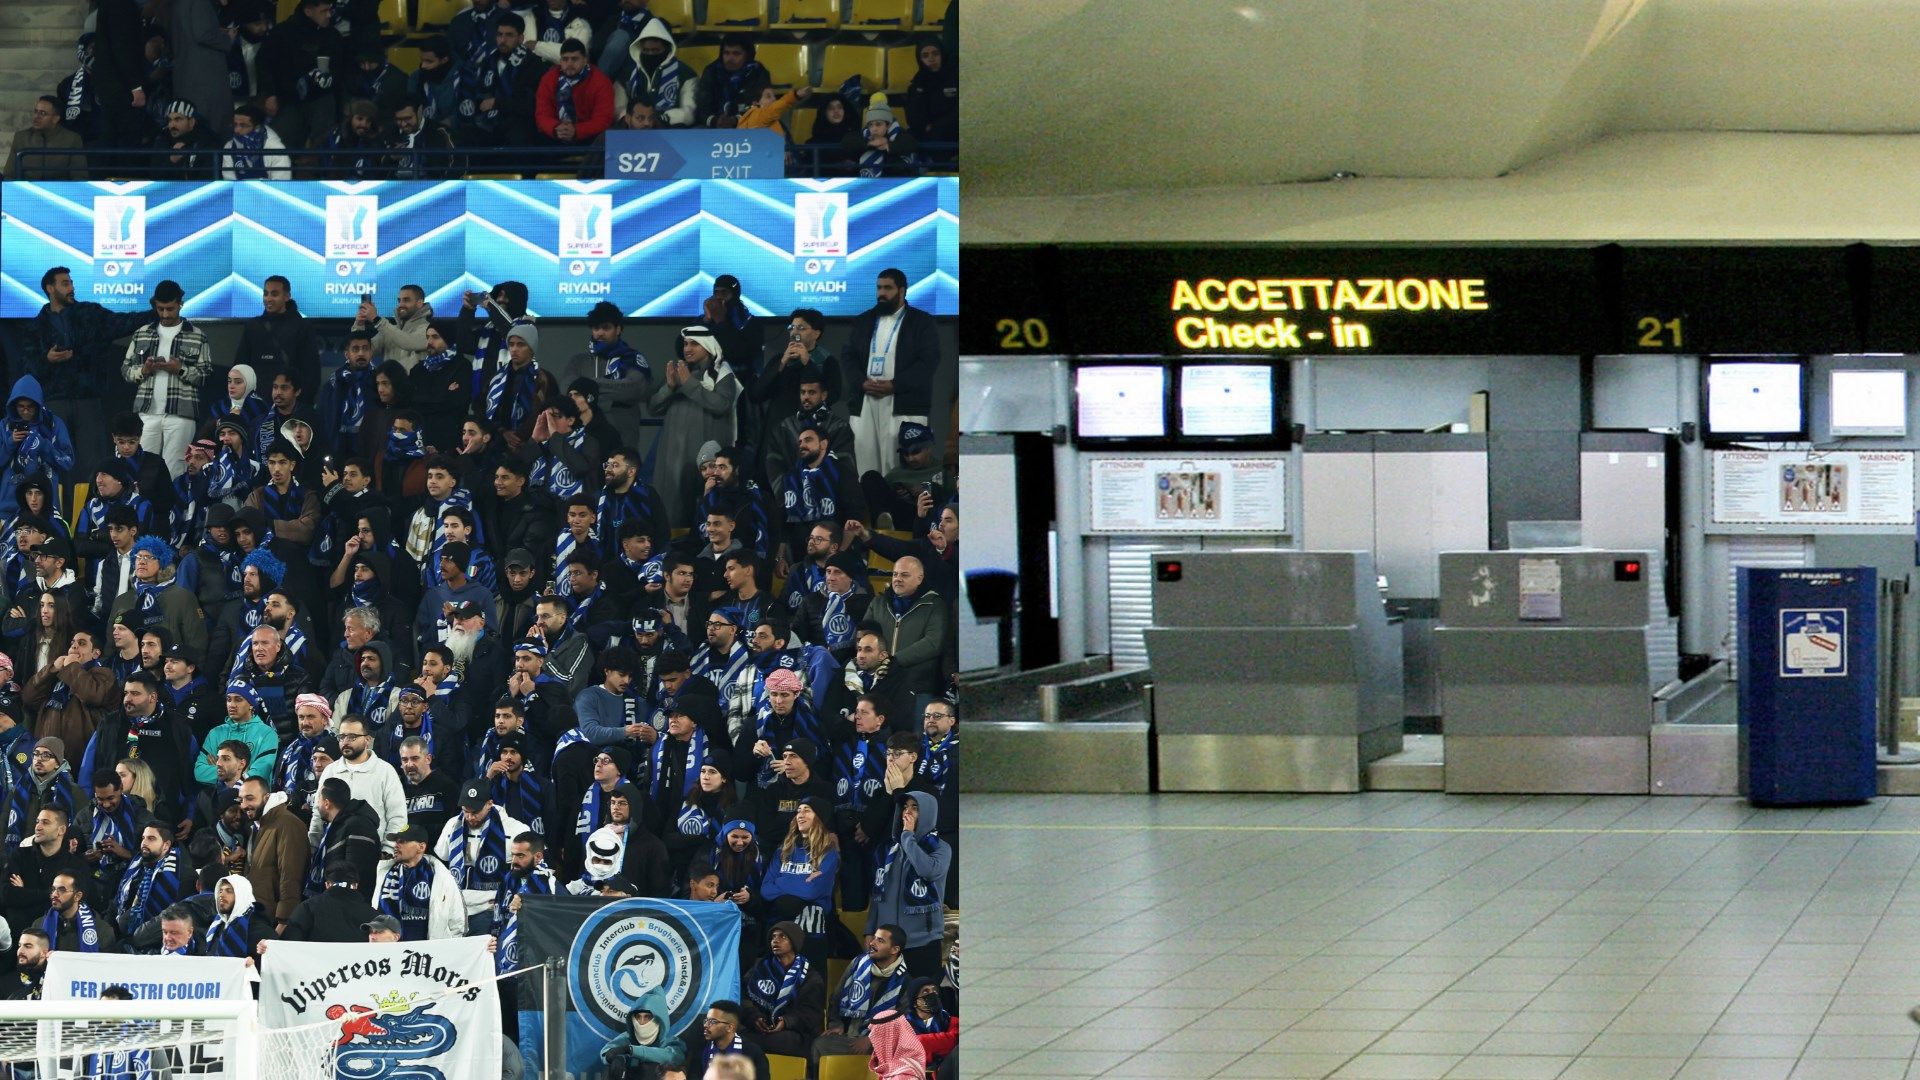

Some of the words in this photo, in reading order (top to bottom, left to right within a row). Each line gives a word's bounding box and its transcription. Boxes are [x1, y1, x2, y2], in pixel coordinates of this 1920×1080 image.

[711, 138, 752, 158] خروج
[618, 152, 660, 173] S27
[711, 165, 752, 179] EXIT
[93, 283, 144, 294] RIYADH
[325, 283, 377, 294] RIYADH
[558, 282, 611, 294] RIYADH
[794, 281, 847, 293] RIYADH
[1171, 278, 1489, 311] ACCETTAZIONE
[996, 318, 1049, 348] 20
[1175, 316, 1301, 348] Check
[1330, 316, 1371, 348] in
[1638, 316, 1682, 347] 21
[1230, 461, 1277, 469] WARNING
[599, 922, 635, 950] Interclub
[648, 922, 683, 954] Brugherio
[71, 980, 97, 999] PER
[166, 981, 221, 1000] COLORI
[281, 957, 392, 1015] Vipereos
[400, 949, 482, 1002] Mores
[592, 953, 629, 1019] oltopiùcheunclub
[669, 955, 689, 1006] Black&Blue
